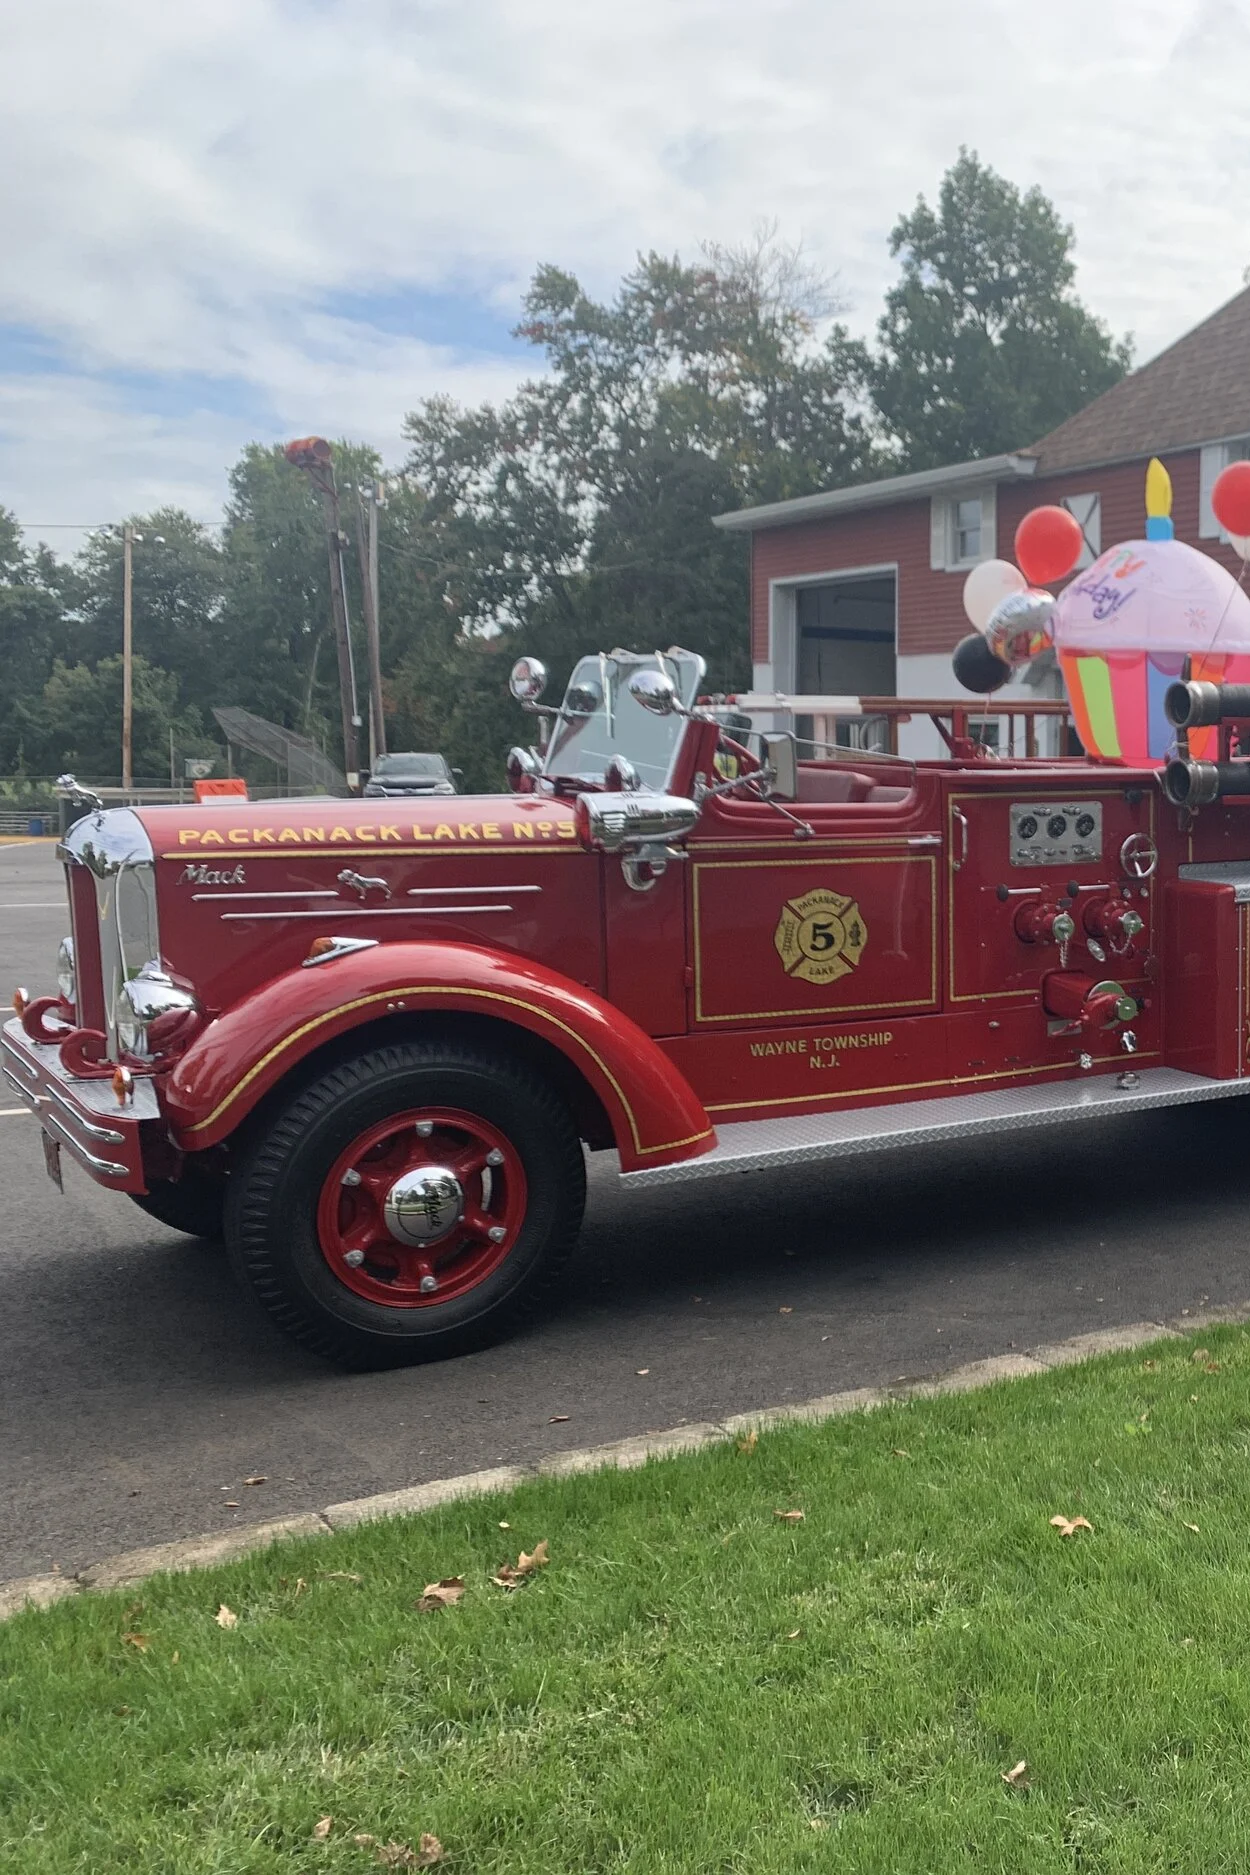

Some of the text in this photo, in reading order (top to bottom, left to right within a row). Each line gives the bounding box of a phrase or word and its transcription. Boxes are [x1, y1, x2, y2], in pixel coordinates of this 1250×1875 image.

[178, 824, 403, 846] PACKANACK
[412, 820, 503, 842] LAKE
[176, 864, 246, 886] Mack
[797, 895, 845, 912] PACKANACK
[809, 921, 836, 952] 5
[809, 965, 836, 976] LAKE
[750, 1031, 893, 1057] WAYNE TOWNSHIP
[809, 1054, 841, 1069] N.J.
